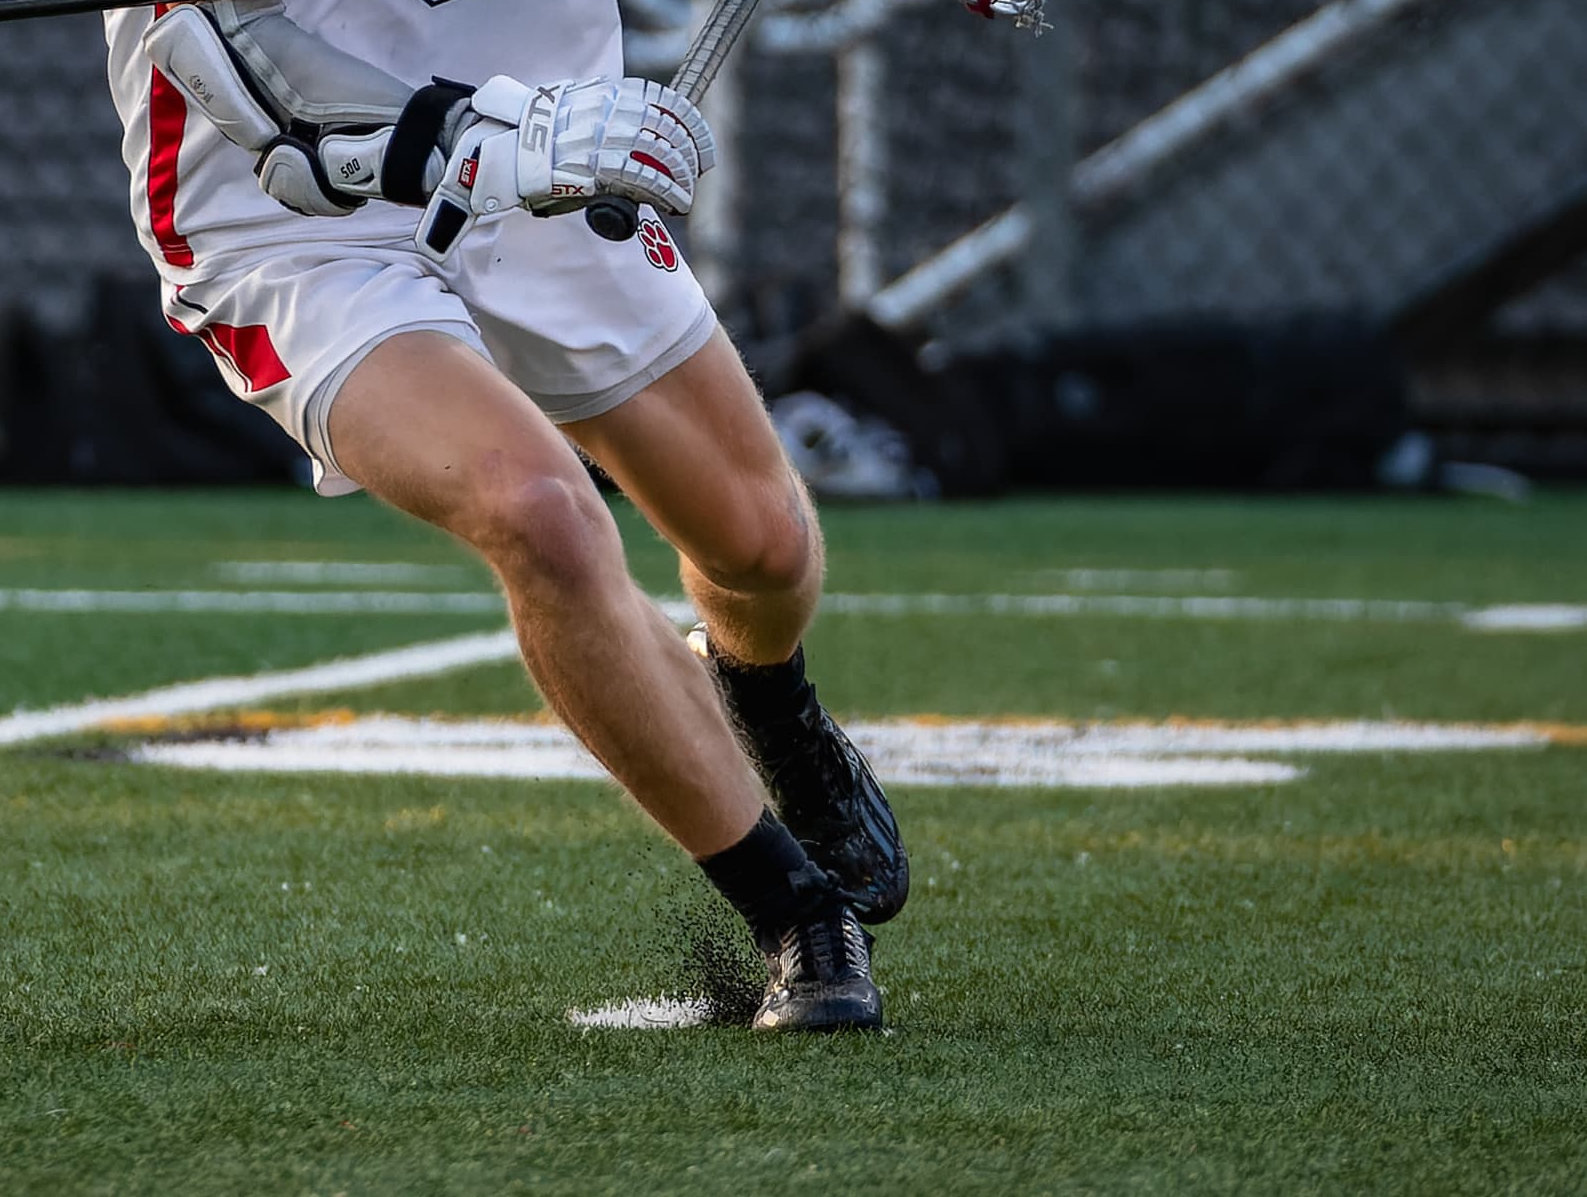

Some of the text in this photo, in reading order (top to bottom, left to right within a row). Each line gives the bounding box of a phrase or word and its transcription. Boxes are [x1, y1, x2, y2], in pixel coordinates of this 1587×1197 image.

[522, 84, 561, 154] STX
[340, 157, 361, 179] 500
[462, 159, 473, 184] STX
[551, 184, 585, 196] STX
